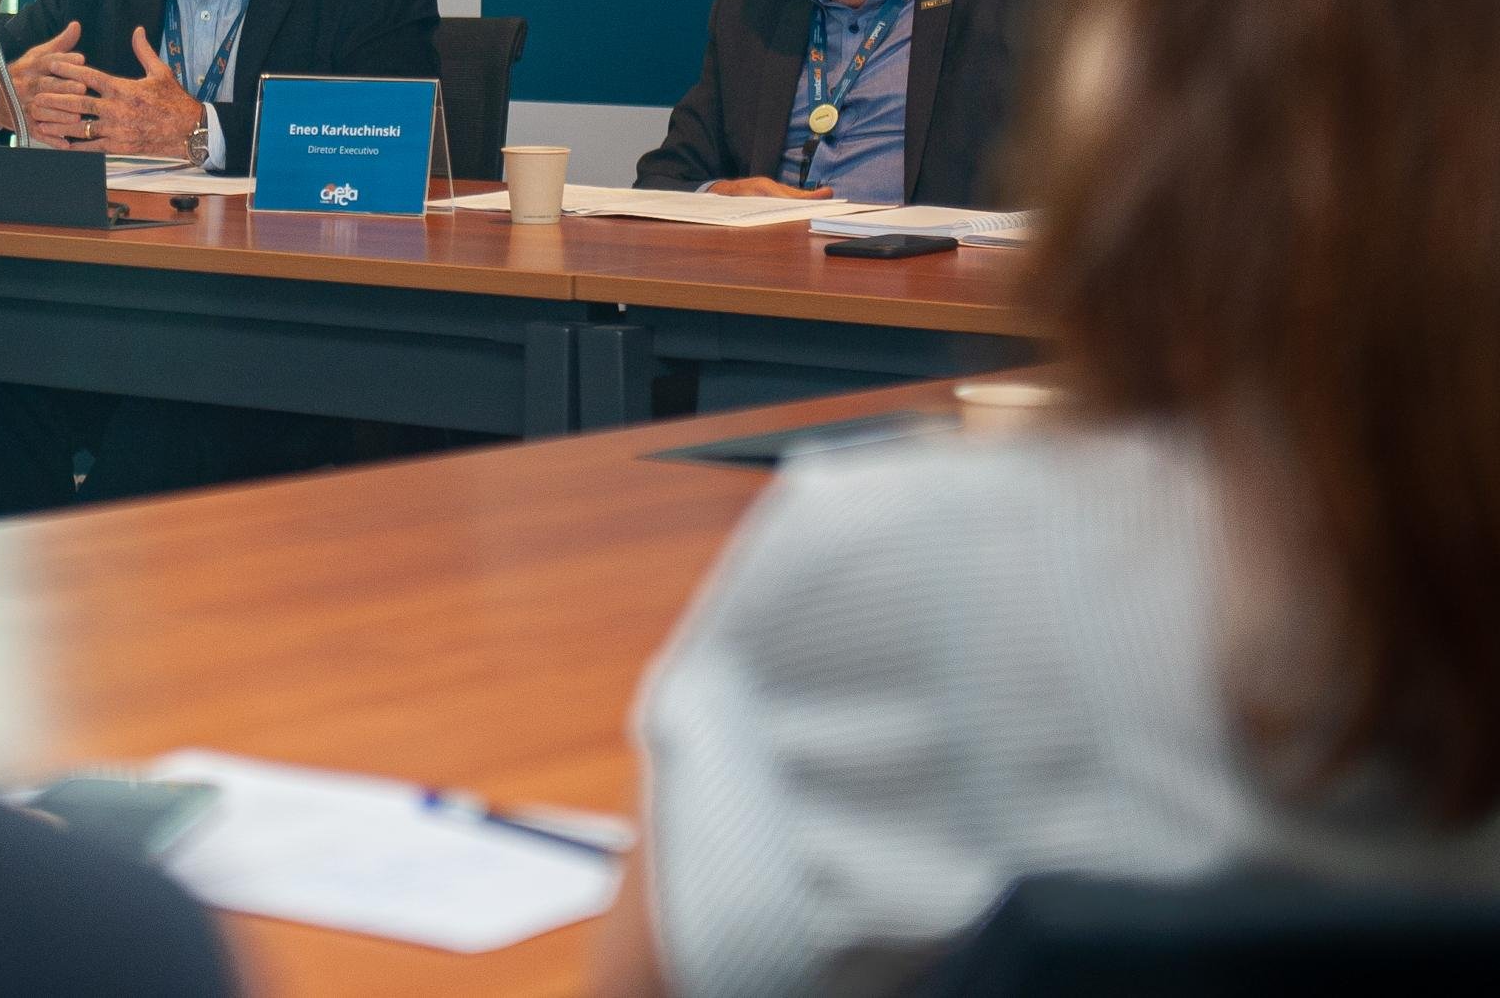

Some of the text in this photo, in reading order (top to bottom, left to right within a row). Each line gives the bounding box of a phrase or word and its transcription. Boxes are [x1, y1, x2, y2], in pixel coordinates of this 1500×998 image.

[289, 124, 401, 137] Eneo Karkuchinski
[308, 145, 379, 155] Diretor Executivo
